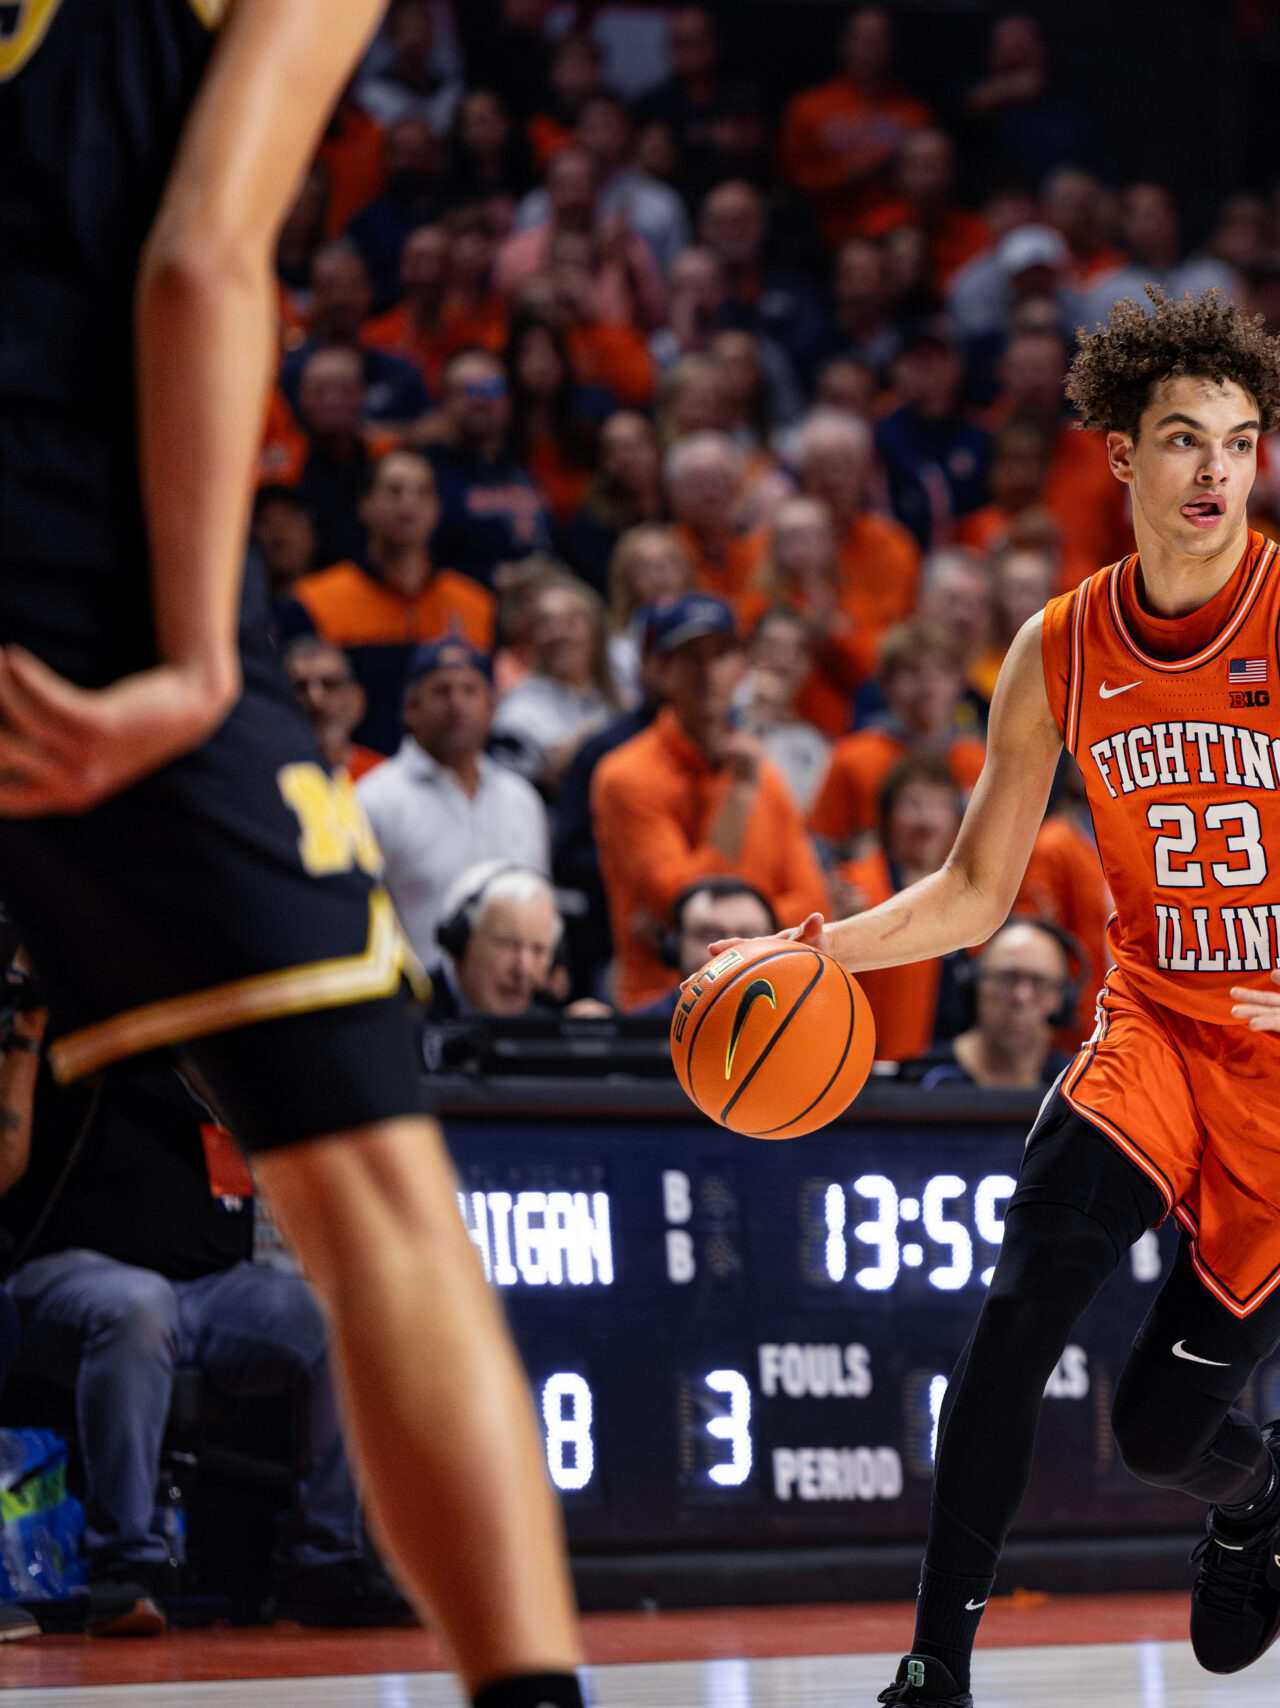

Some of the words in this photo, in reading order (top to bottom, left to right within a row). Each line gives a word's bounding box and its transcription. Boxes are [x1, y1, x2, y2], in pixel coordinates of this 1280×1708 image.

[1146, 800, 1268, 888] 23
[456, 1191, 614, 1286] HIGAN
[758, 1343, 872, 1398] FOULS
[704, 1369, 752, 1487] 3
[772, 1446, 903, 1501] PERIOD
